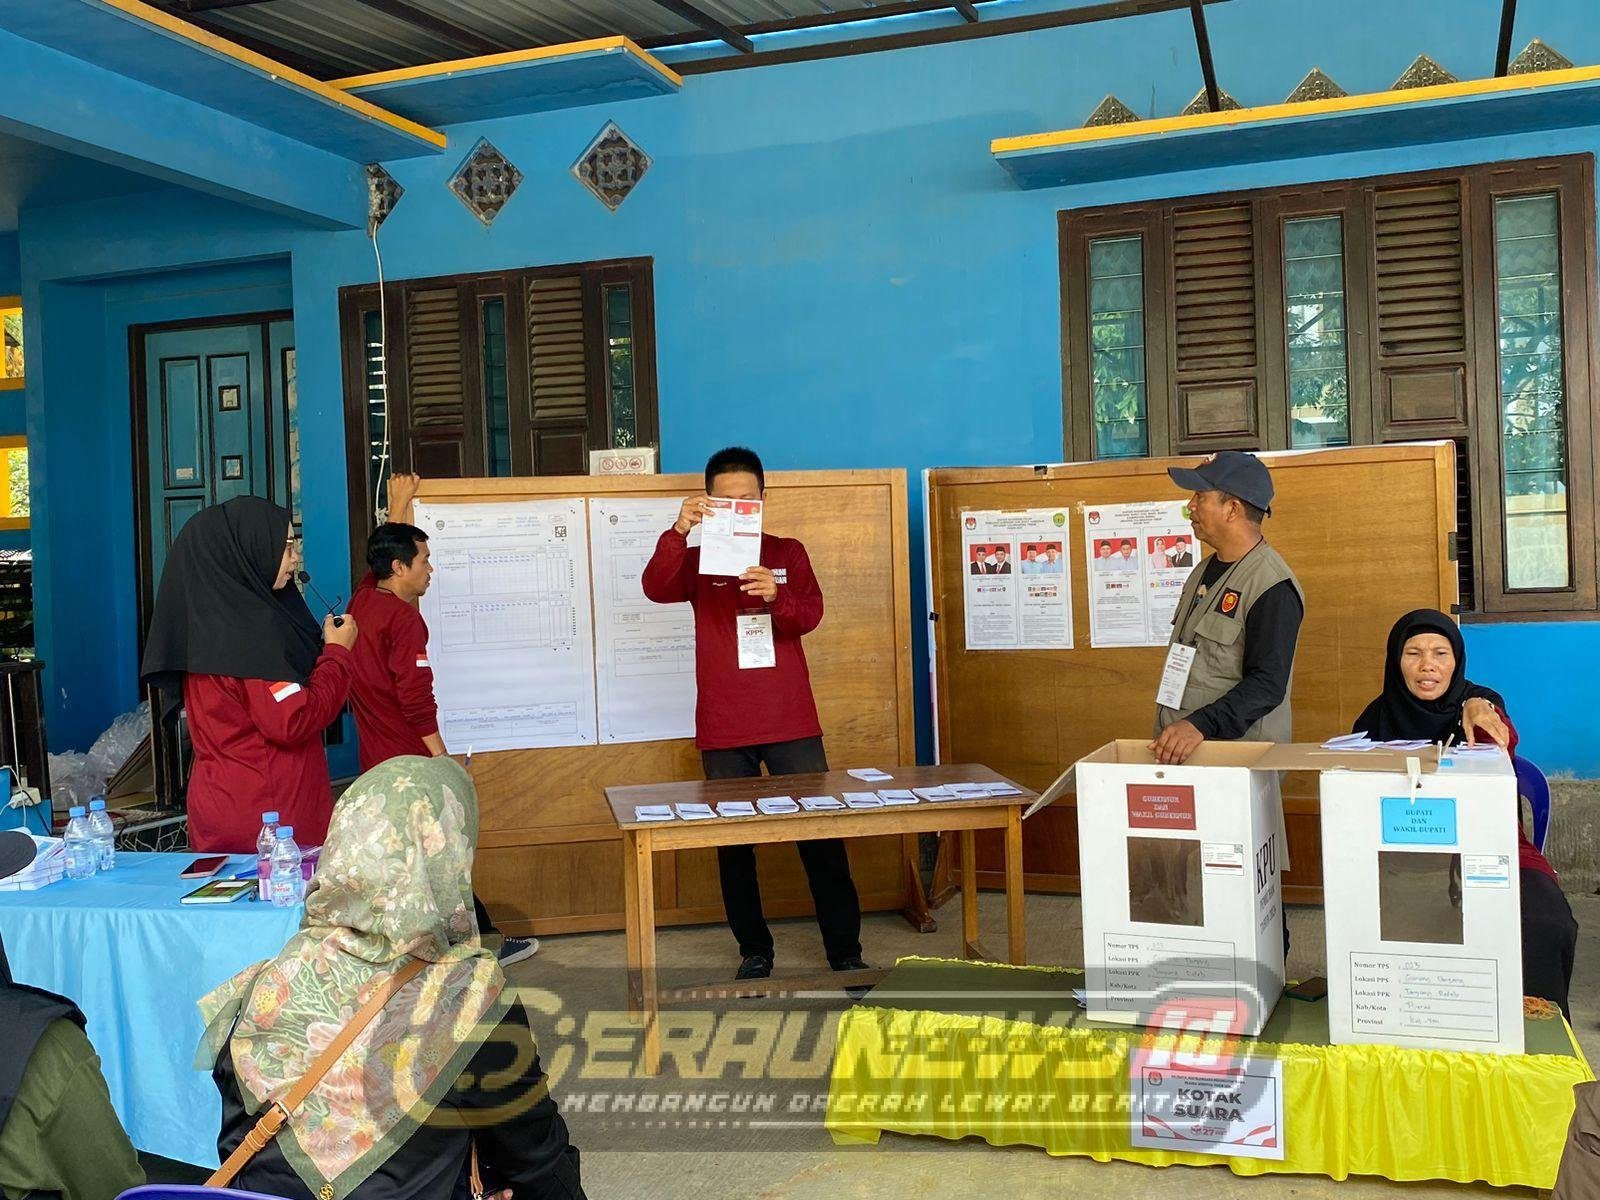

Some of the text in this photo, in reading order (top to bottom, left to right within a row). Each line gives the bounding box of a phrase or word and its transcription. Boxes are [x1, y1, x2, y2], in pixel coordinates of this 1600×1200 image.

[1256, 833, 1276, 895] KPU
[1354, 961, 1376, 969] Nomor
[1354, 975, 1376, 983] Lokasi
[1355, 989, 1376, 997] Lokasi
[1356, 1003, 1387, 1012] Kab/Kota
[1178, 1088, 1242, 1105] KOTAK
[1173, 1103, 1246, 1123] SUARA
[1203, 1128, 1215, 1136] 27
